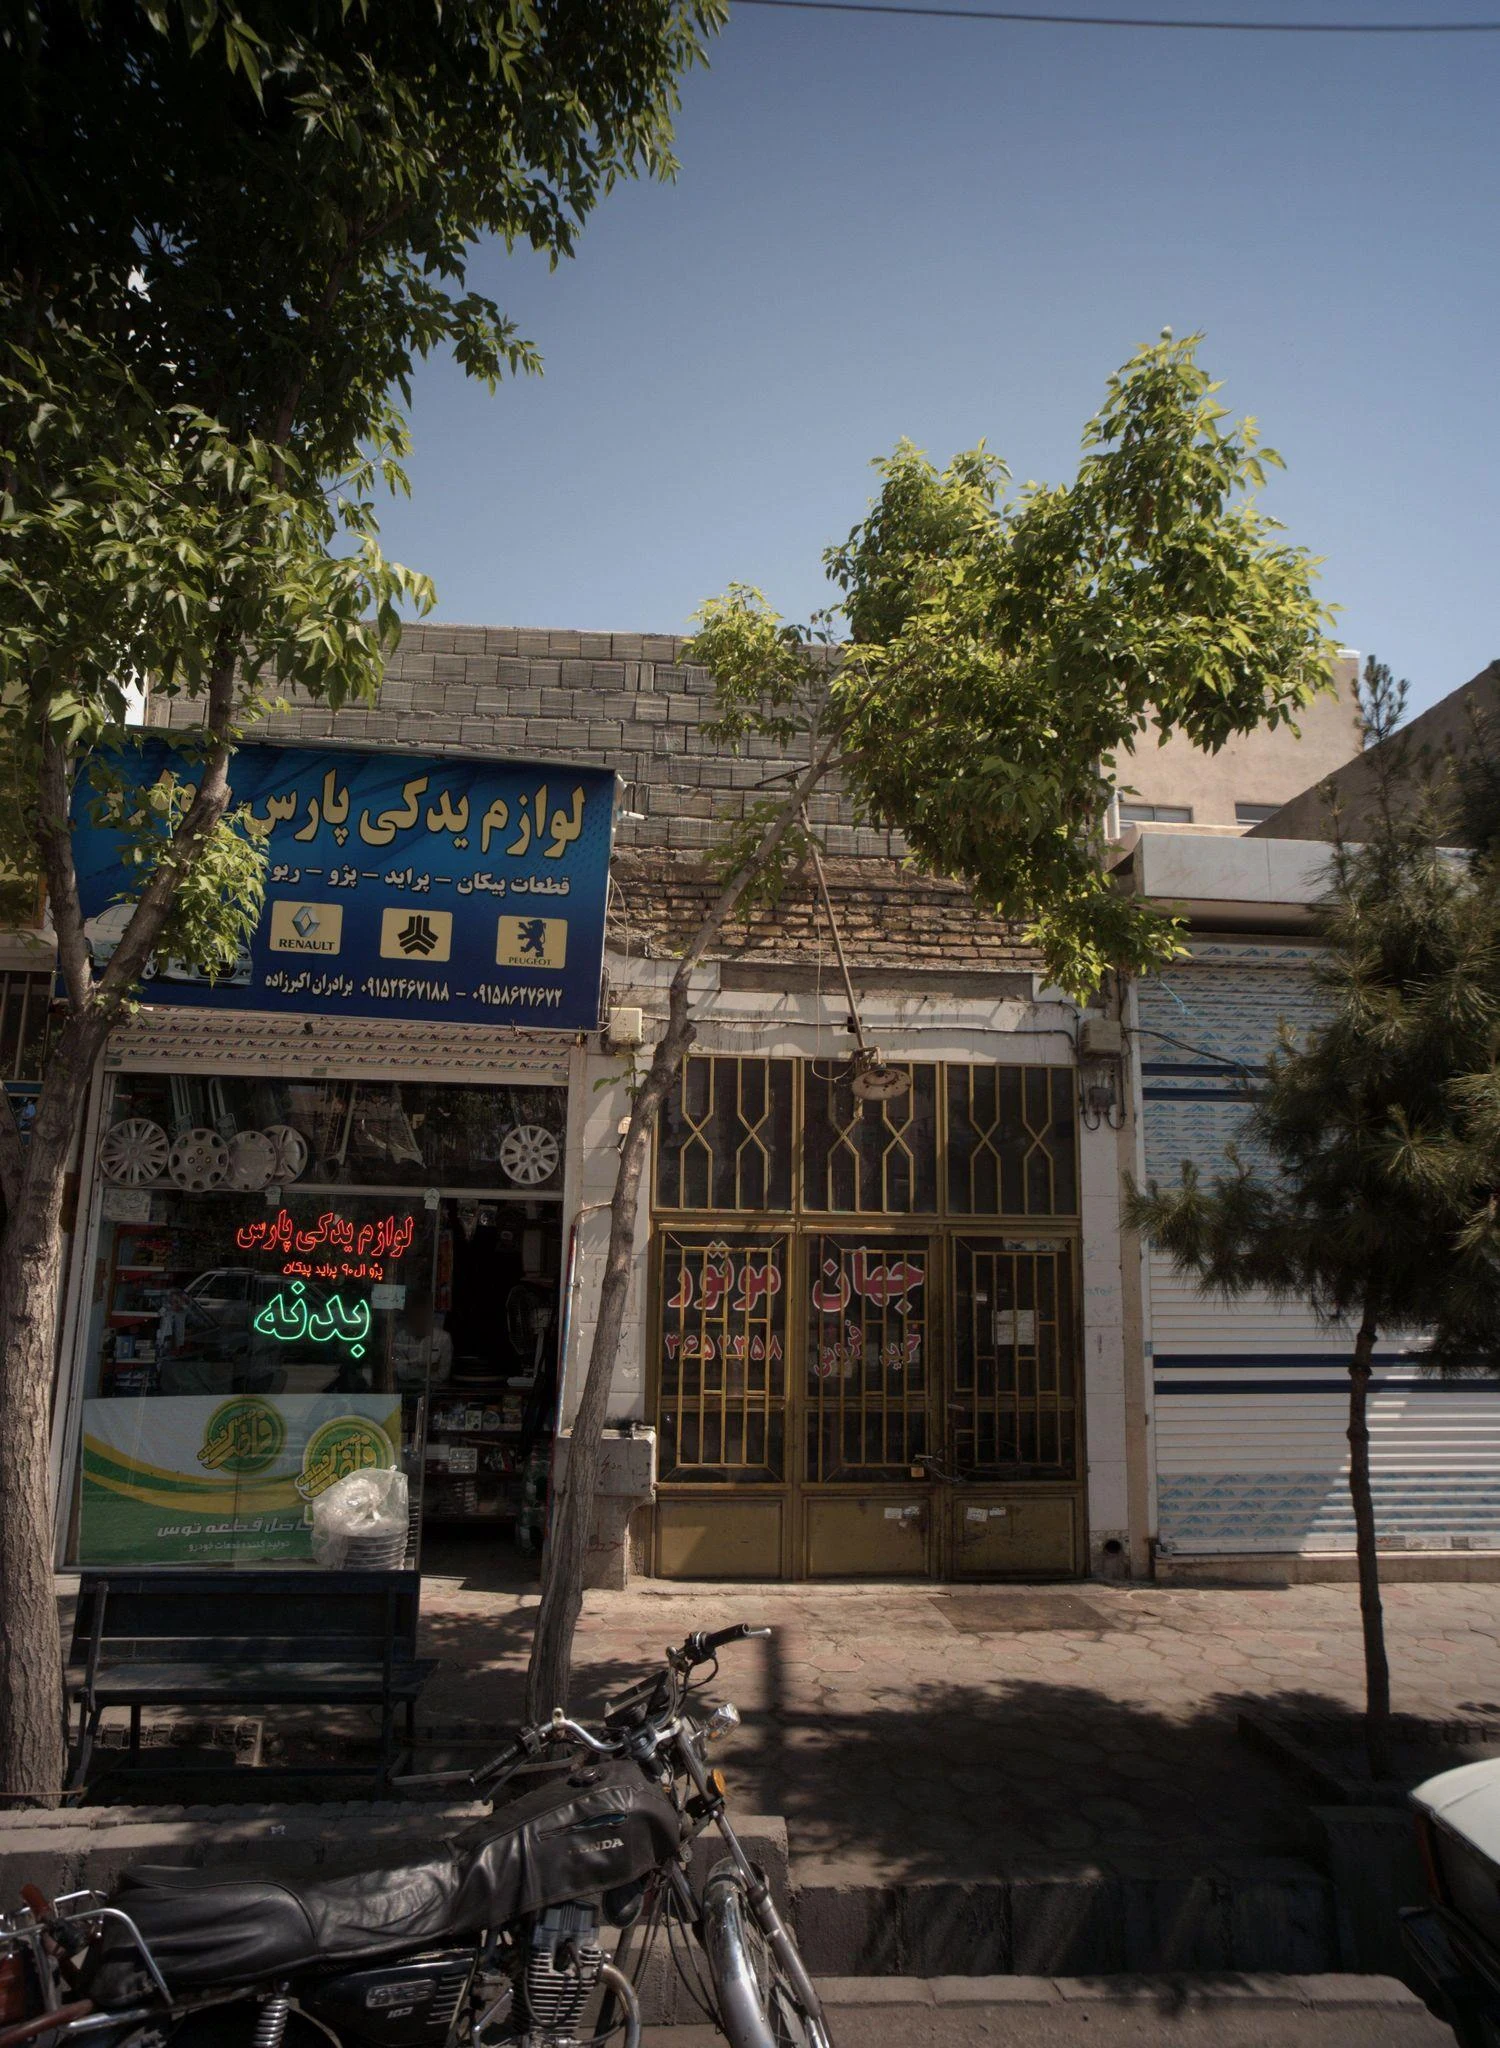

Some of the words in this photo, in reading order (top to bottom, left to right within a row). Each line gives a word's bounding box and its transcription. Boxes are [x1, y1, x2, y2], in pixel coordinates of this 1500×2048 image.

[243, 767, 350, 848] پارس
[358, 775, 469, 848] یدکی
[480, 783, 586, 859] لوازم
[270, 862, 301, 883] ریو
[327, 863, 358, 888] پژو
[384, 867, 430, 892] پراید
[456, 871, 506, 897] پیکان
[510, 875, 571, 896] قطعات
[278, 938, 335, 951] RENAULT
[508, 956, 552, 966] PEUGEOT
[265, 970, 311, 993] اکبرزاده
[311, 973, 354, 996] برادران
[237, 1209, 293, 1253] پارس
[295, 1212, 355, 1253] یدکی
[357, 1216, 414, 1258] لوازم
[283, 1261, 312, 1278] پیکان
[315, 1262, 338, 1279] پراید
[369, 1262, 383, 1280] پژو
[667, 1240, 782, 1311] موتور
[812, 1245, 925, 1316] جهان
[253, 1280, 371, 1358] بدنه
[157, 1522, 203, 1537] توس
[205, 1517, 265, 1534] قطعه
[264, 1516, 314, 1533] اضل
[568, 1838, 625, 1854] ONDA
